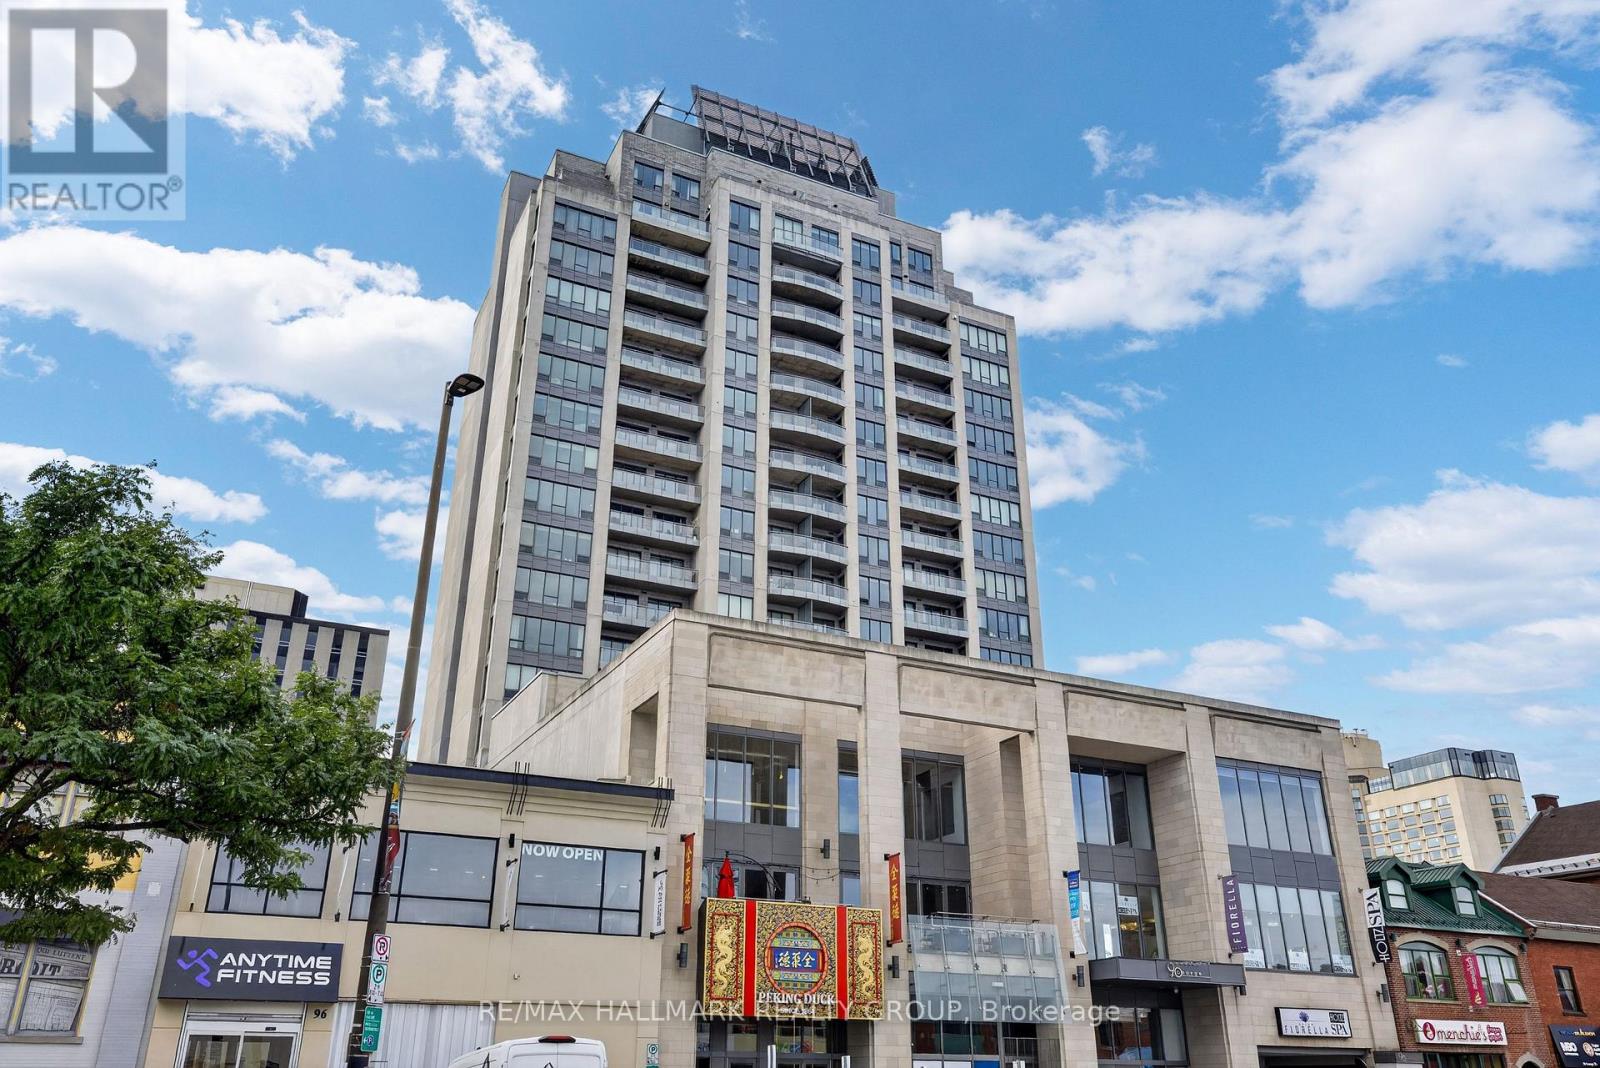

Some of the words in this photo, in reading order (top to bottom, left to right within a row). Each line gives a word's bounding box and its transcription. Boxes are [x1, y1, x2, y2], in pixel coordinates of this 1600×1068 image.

[522, 843, 560, 858] NOW
[562, 846, 604, 861] OPEN
[1226, 879, 1242, 944] FIORELLA
[1366, 892, 1383, 926] SPA
[1373, 925, 1391, 963] HOLTZ
[220, 952, 333, 970] ANYTIME
[216, 968, 331, 986] FITNESS
[758, 991, 802, 1004] PEKING
[804, 993, 836, 1006] DUCK
[313, 1009, 327, 1019] 96
[1284, 1024, 1329, 1035] FIORELLA
[1331, 1023, 1348, 1035] SPA
